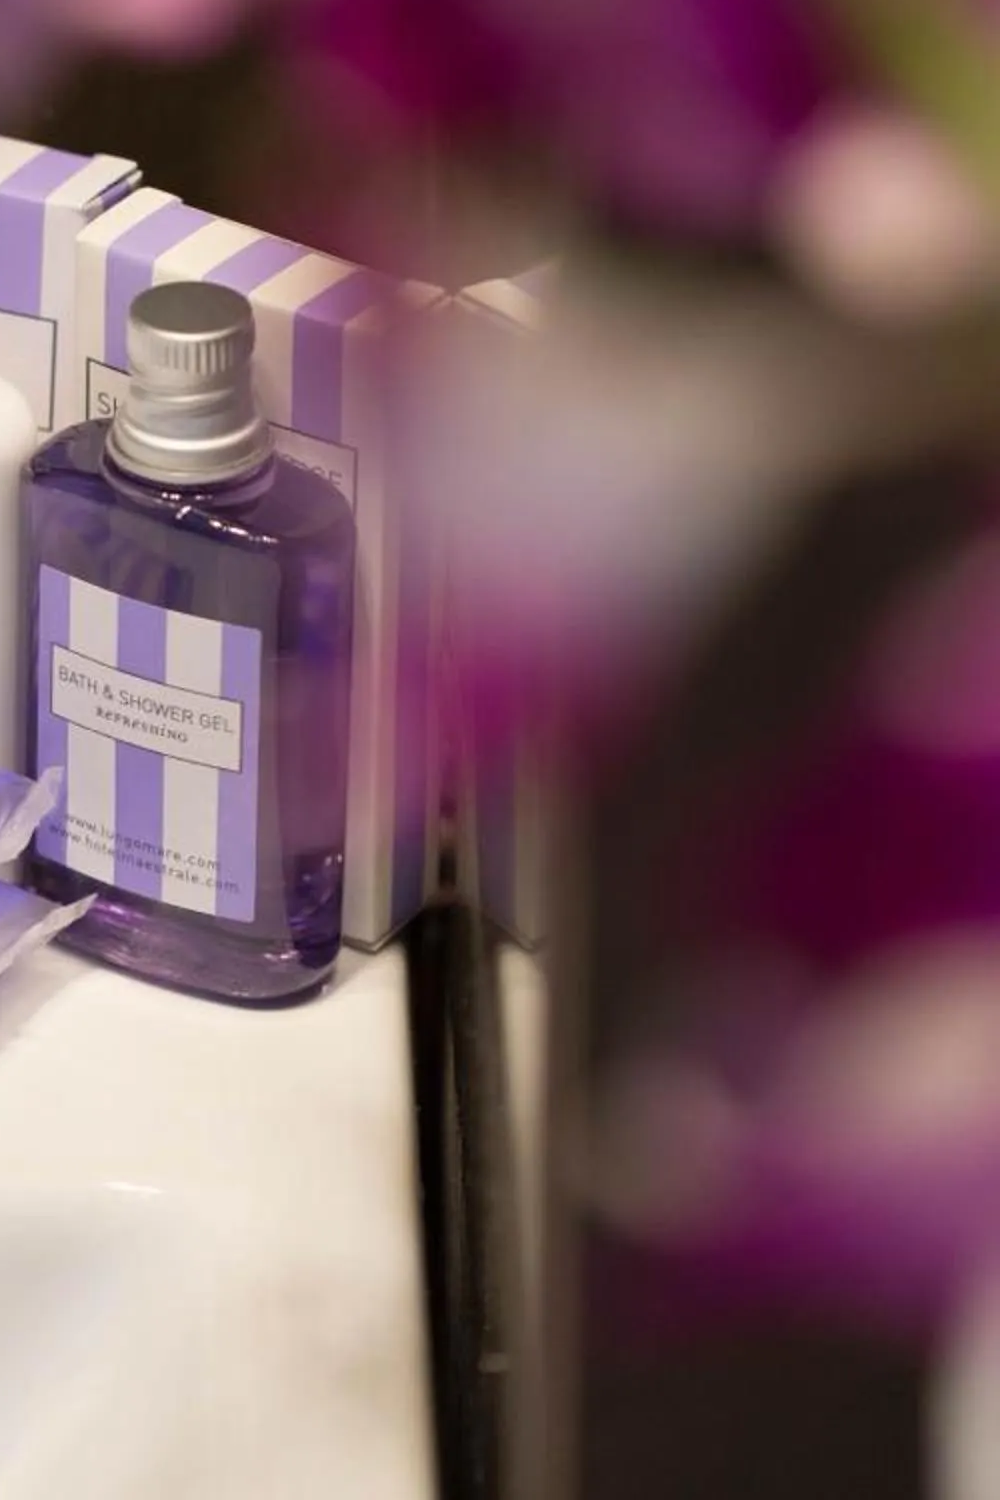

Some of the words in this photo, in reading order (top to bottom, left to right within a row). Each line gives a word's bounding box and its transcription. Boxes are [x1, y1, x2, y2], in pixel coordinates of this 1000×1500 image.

[58, 665, 99, 694] BATH
[102, 683, 114, 700] &
[119, 690, 194, 726] SHOWER
[199, 713, 234, 734] GEL
